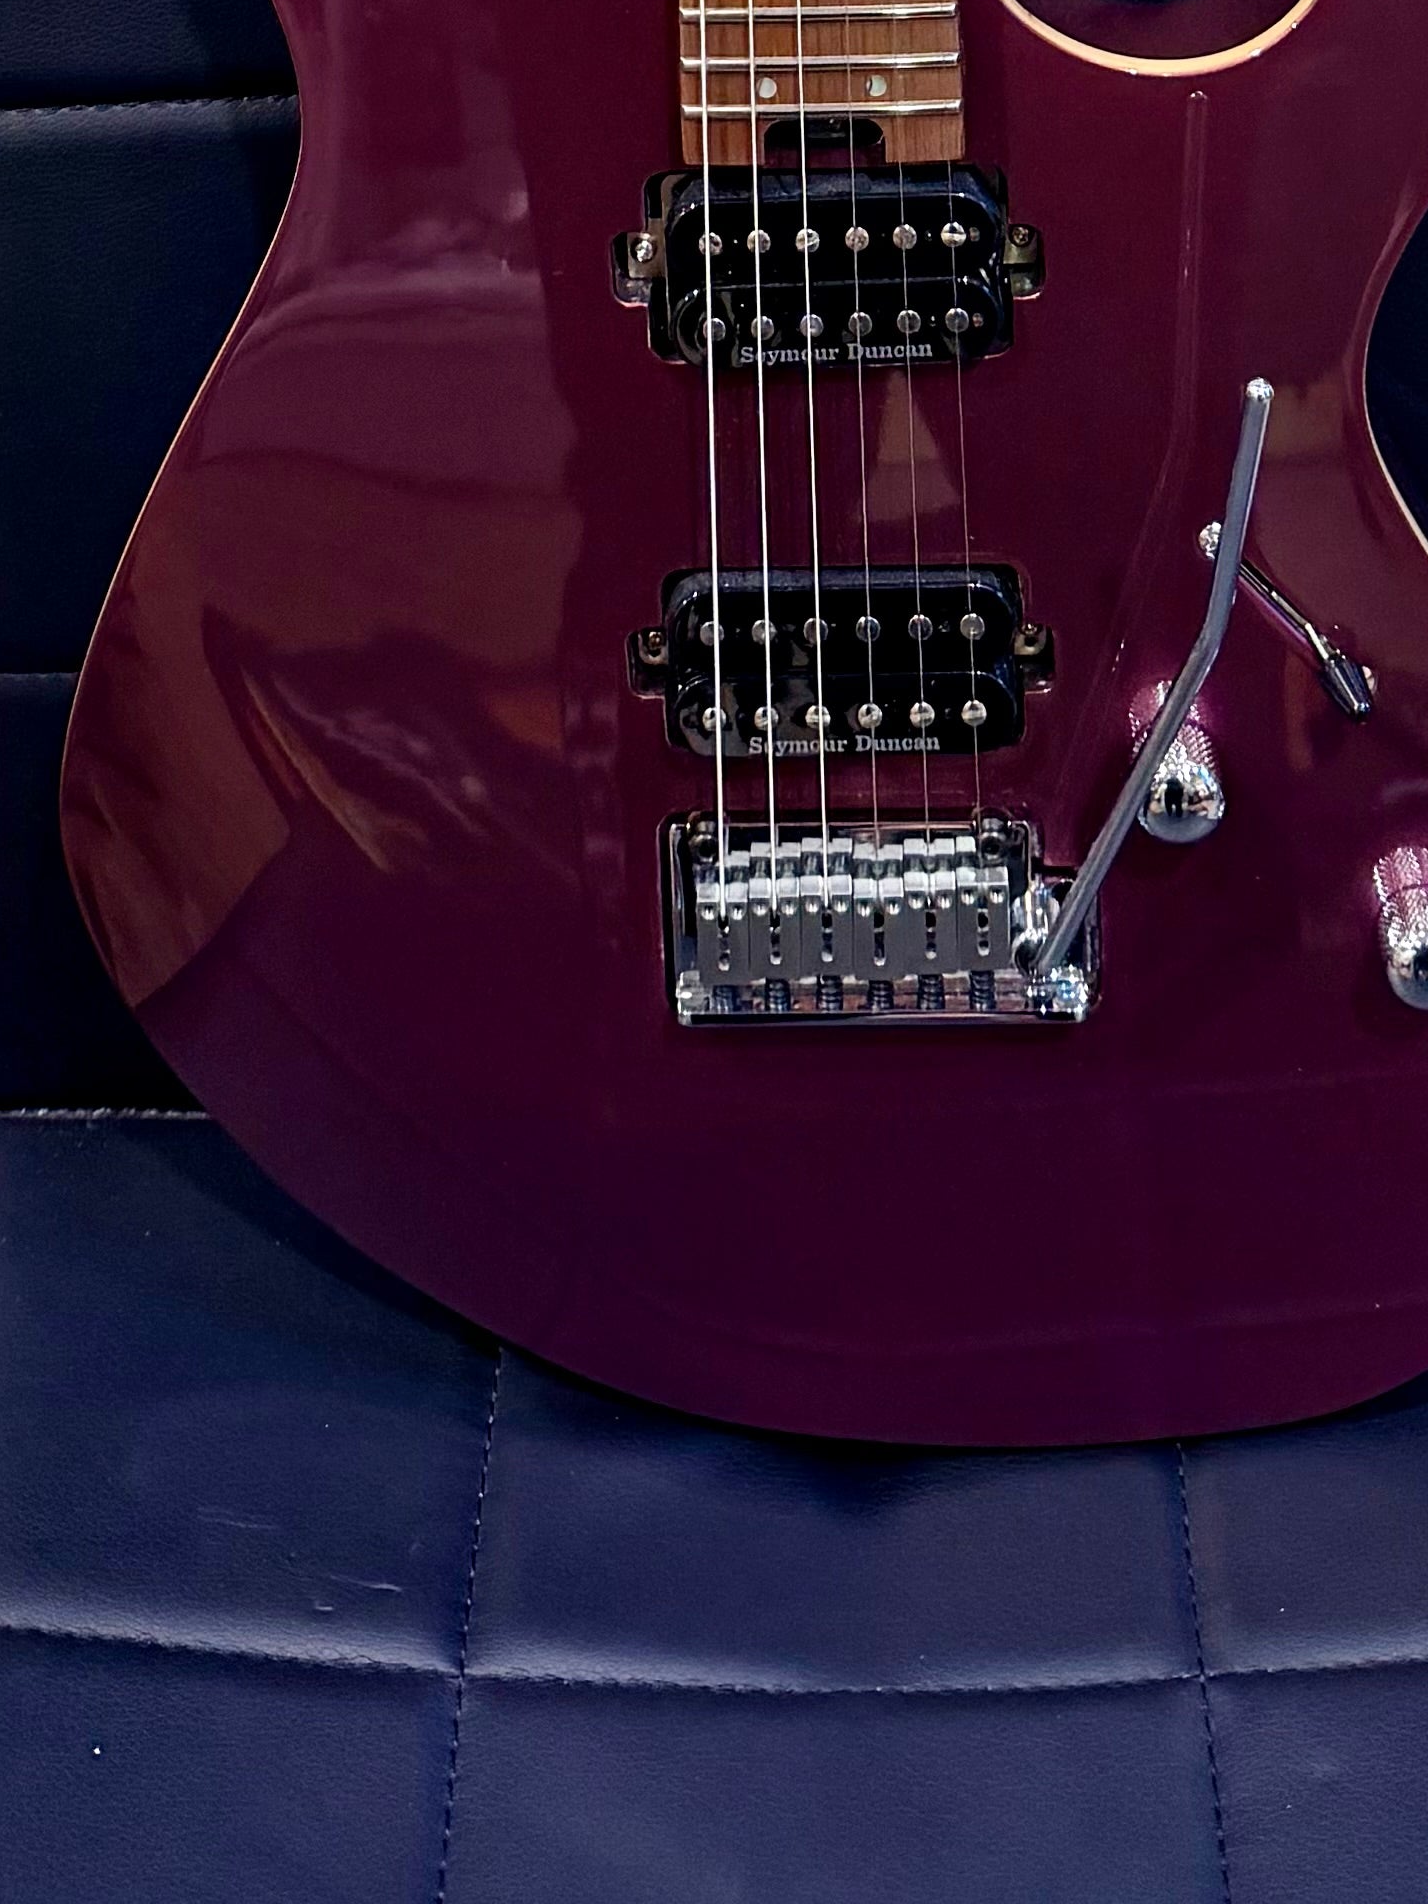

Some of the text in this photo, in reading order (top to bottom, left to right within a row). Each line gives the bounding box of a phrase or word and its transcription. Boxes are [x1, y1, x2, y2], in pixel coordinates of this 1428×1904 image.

[740, 342, 933, 366] Seymour Duncan
[854, 734, 941, 752] Duncan
